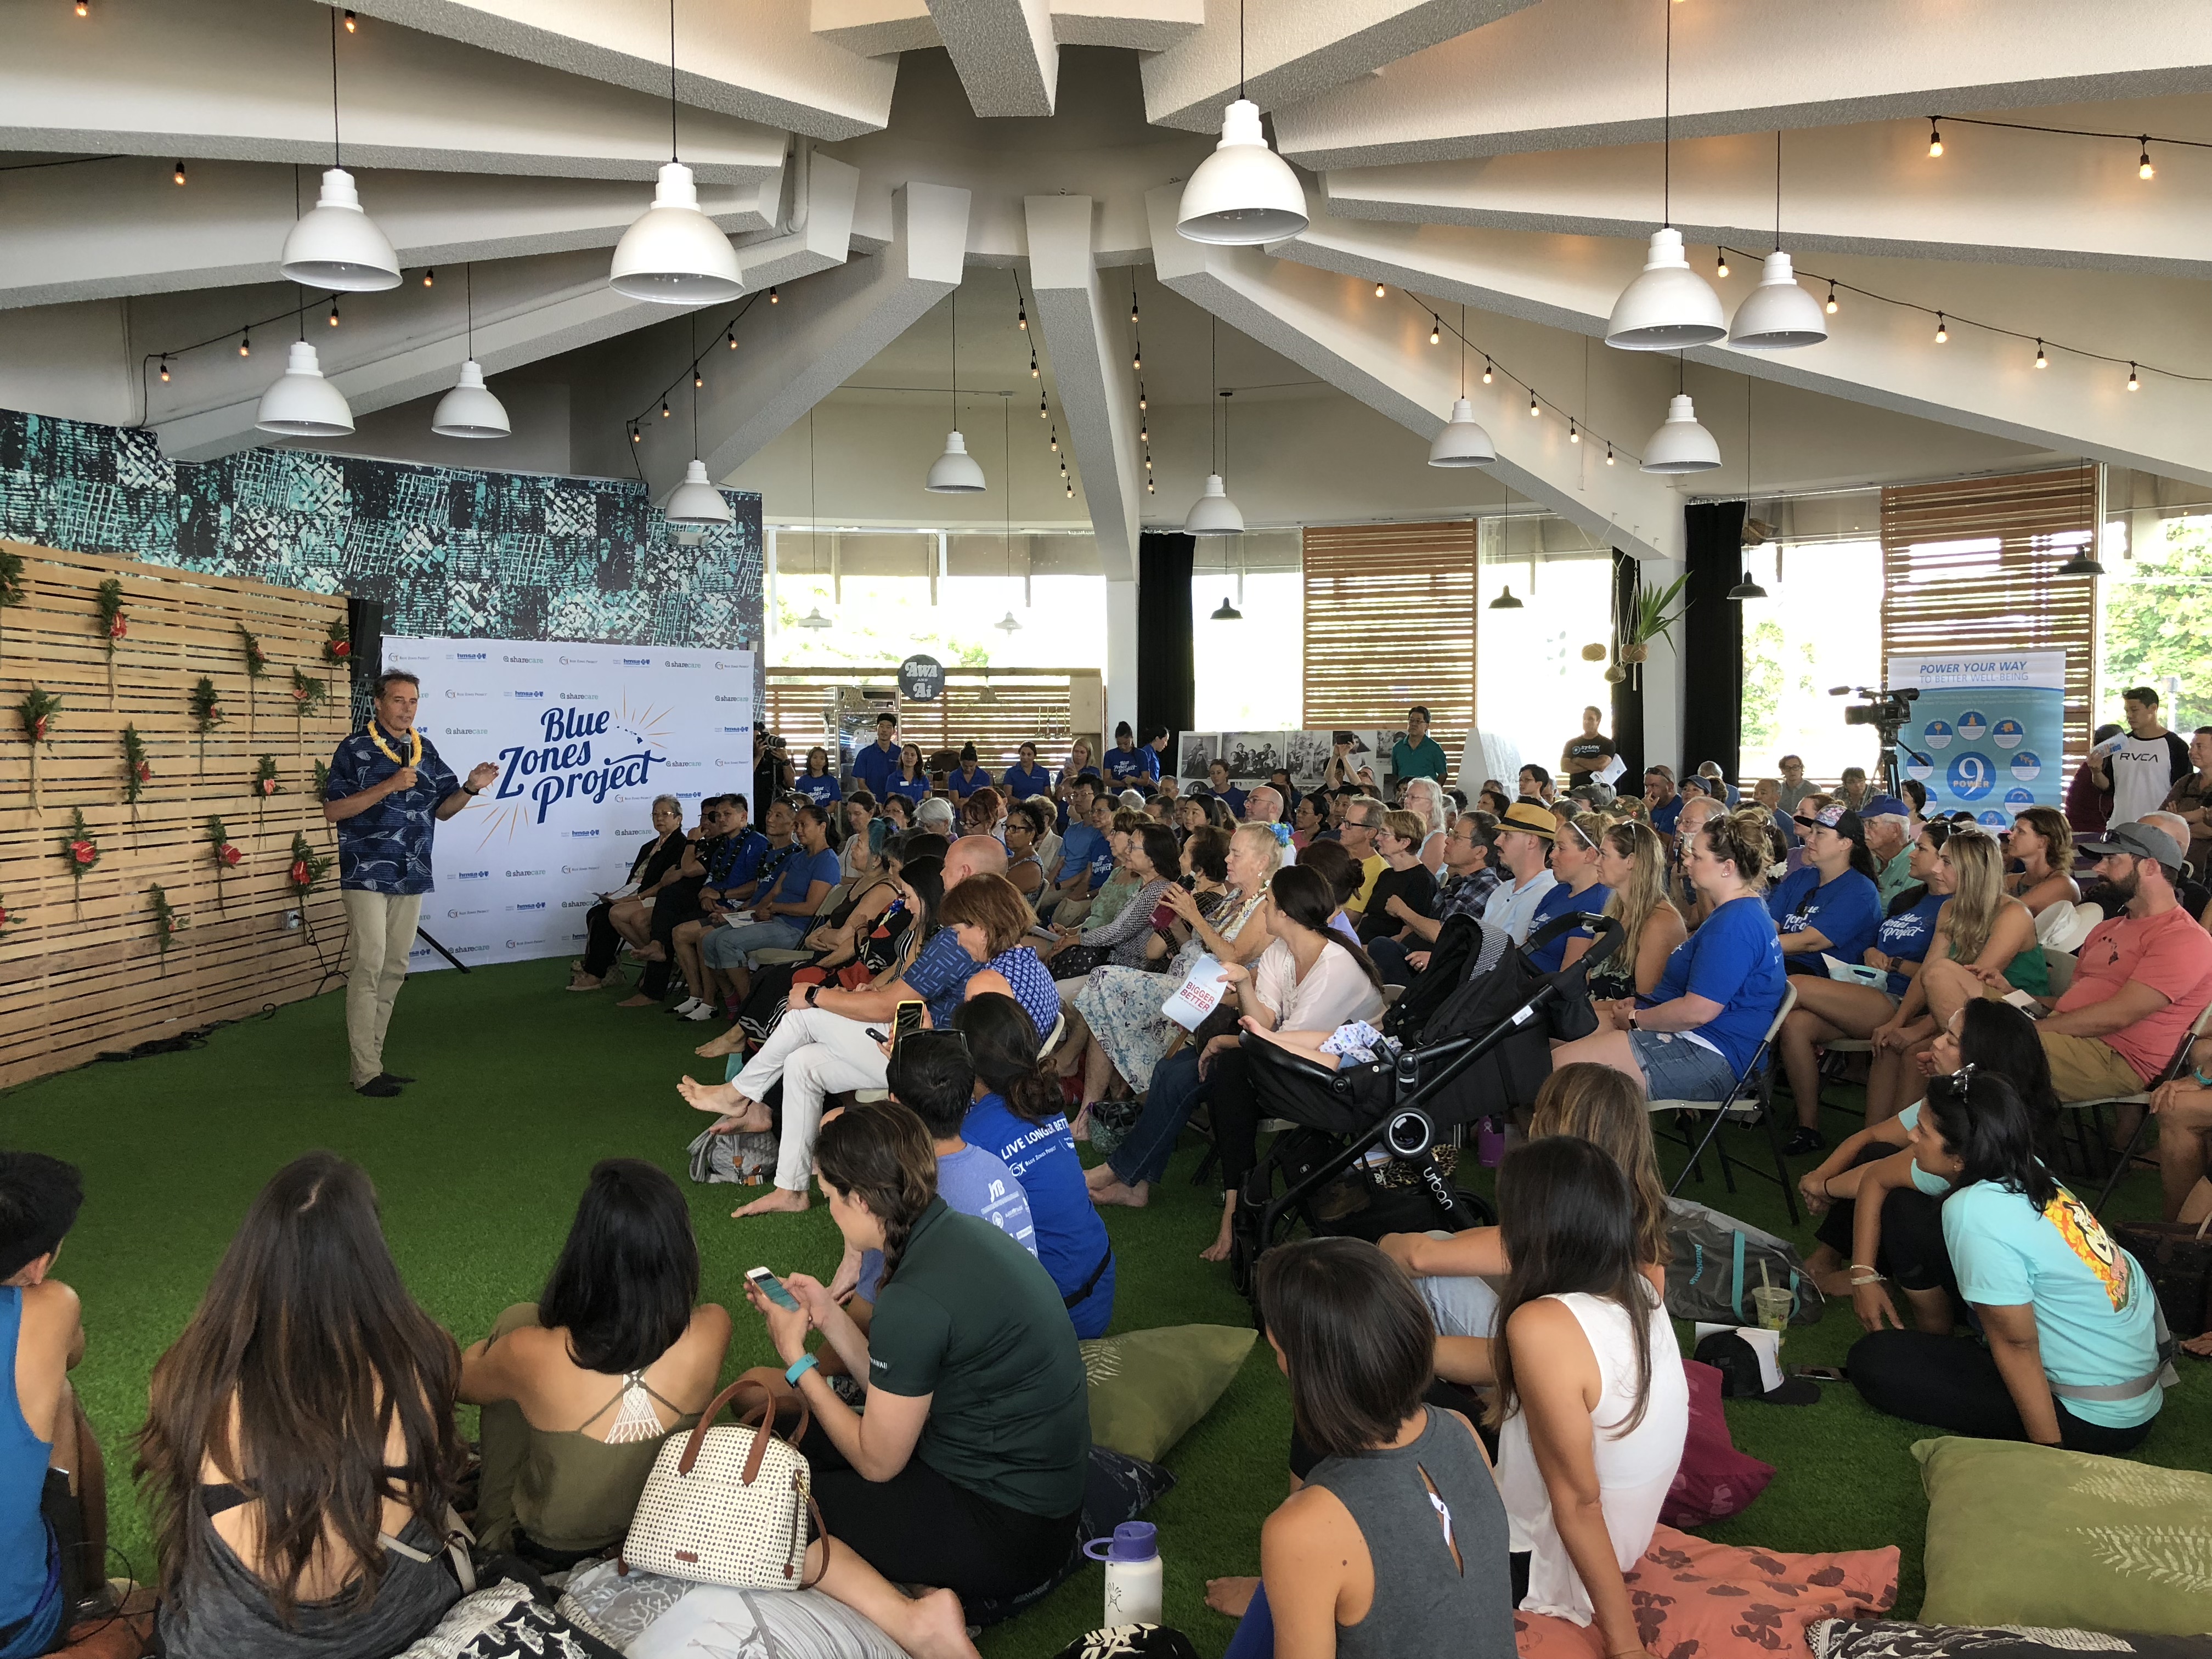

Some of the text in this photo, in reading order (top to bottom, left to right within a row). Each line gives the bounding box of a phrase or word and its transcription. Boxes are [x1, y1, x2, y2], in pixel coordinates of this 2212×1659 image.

[510, 656, 544, 664] sharecare
[905, 662, 938, 678] AWA
[1920, 661, 2028, 674] POWER YOUR WAY
[1920, 672, 2029, 684] TO BETTER WELL-BEING
[541, 707, 610, 743] Blue
[495, 740, 591, 800] Zones
[1958, 757, 1984, 797] 9
[1783, 913, 1809, 930] Zons
[455, 944, 490, 953] sharecare
[1180, 989, 1210, 1013] BETTER.
[1186, 981, 1215, 1006] BIGGER.
[1001, 1137, 1026, 1160] LIVE
[1024, 1122, 1057, 1145] LONGER
[1024, 1157, 1036, 1167] BLUE
[1035, 1150, 1046, 1161] ZONES
[1423, 1166, 1453, 1211] urban
